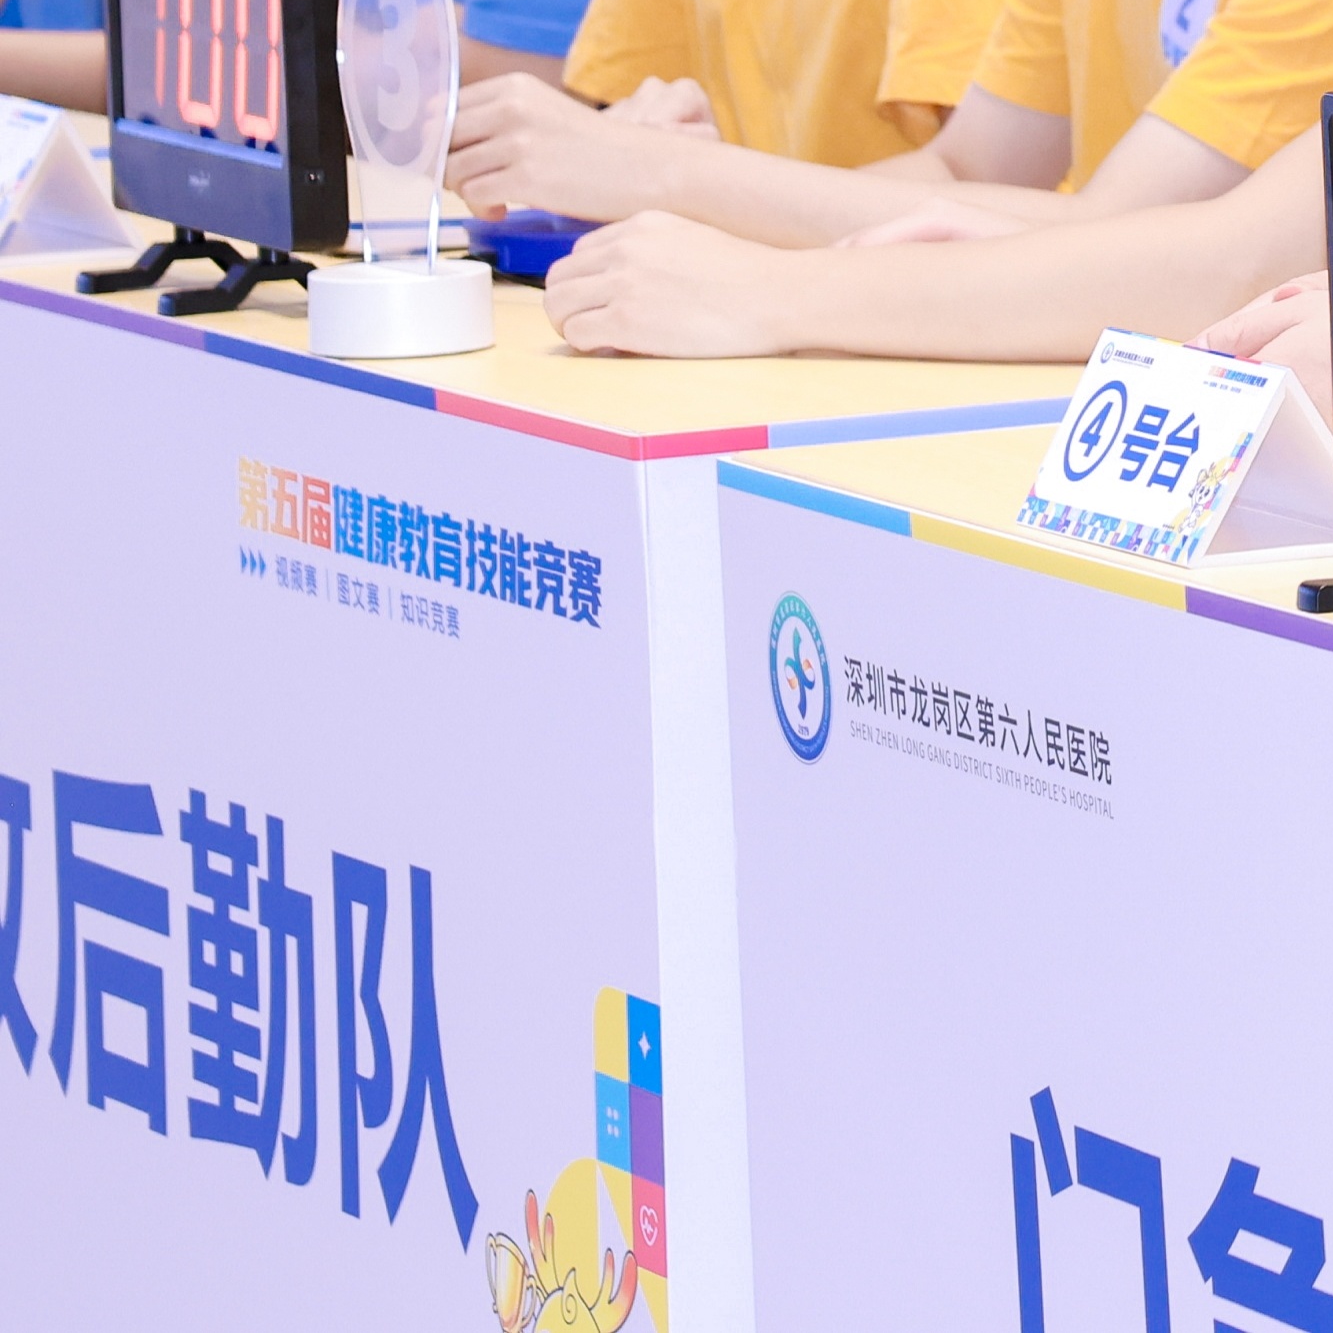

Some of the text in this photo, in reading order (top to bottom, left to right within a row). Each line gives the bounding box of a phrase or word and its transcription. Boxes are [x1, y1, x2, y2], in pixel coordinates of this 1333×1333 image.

[239, 455, 602, 629] 第五届健康教育技能竞赛
[275, 554, 460, 639] 视频赛 图文赛 知识竞赛
[843, 655, 1113, 787] 深圳市龙岗区第六人民医院
[850, 720, 1115, 820] SHEN ZHEN LONG GANG DISTRICT SIXTH PEOPLE'S HOSPITAL
